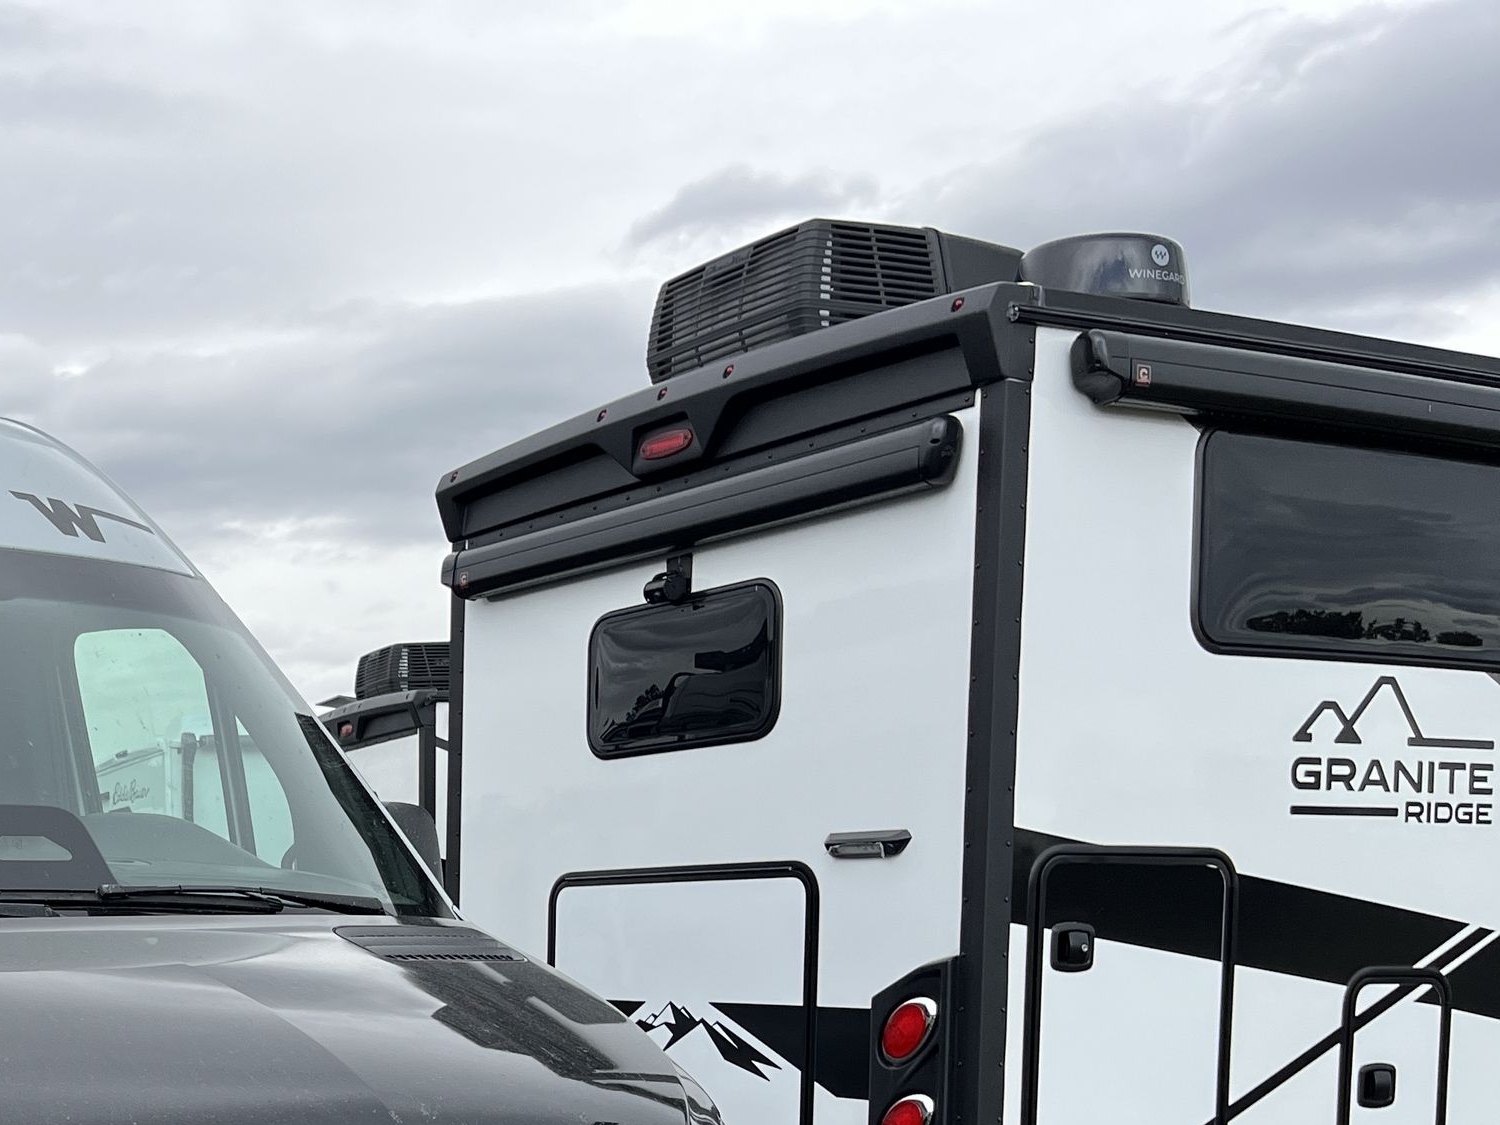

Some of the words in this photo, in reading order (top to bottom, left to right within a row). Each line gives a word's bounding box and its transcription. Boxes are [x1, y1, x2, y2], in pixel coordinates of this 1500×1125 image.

[1128, 268, 1186, 285] WINEGARD
[1290, 756, 1494, 795] GRANITE
[1404, 801, 1493, 825] RIDGE
